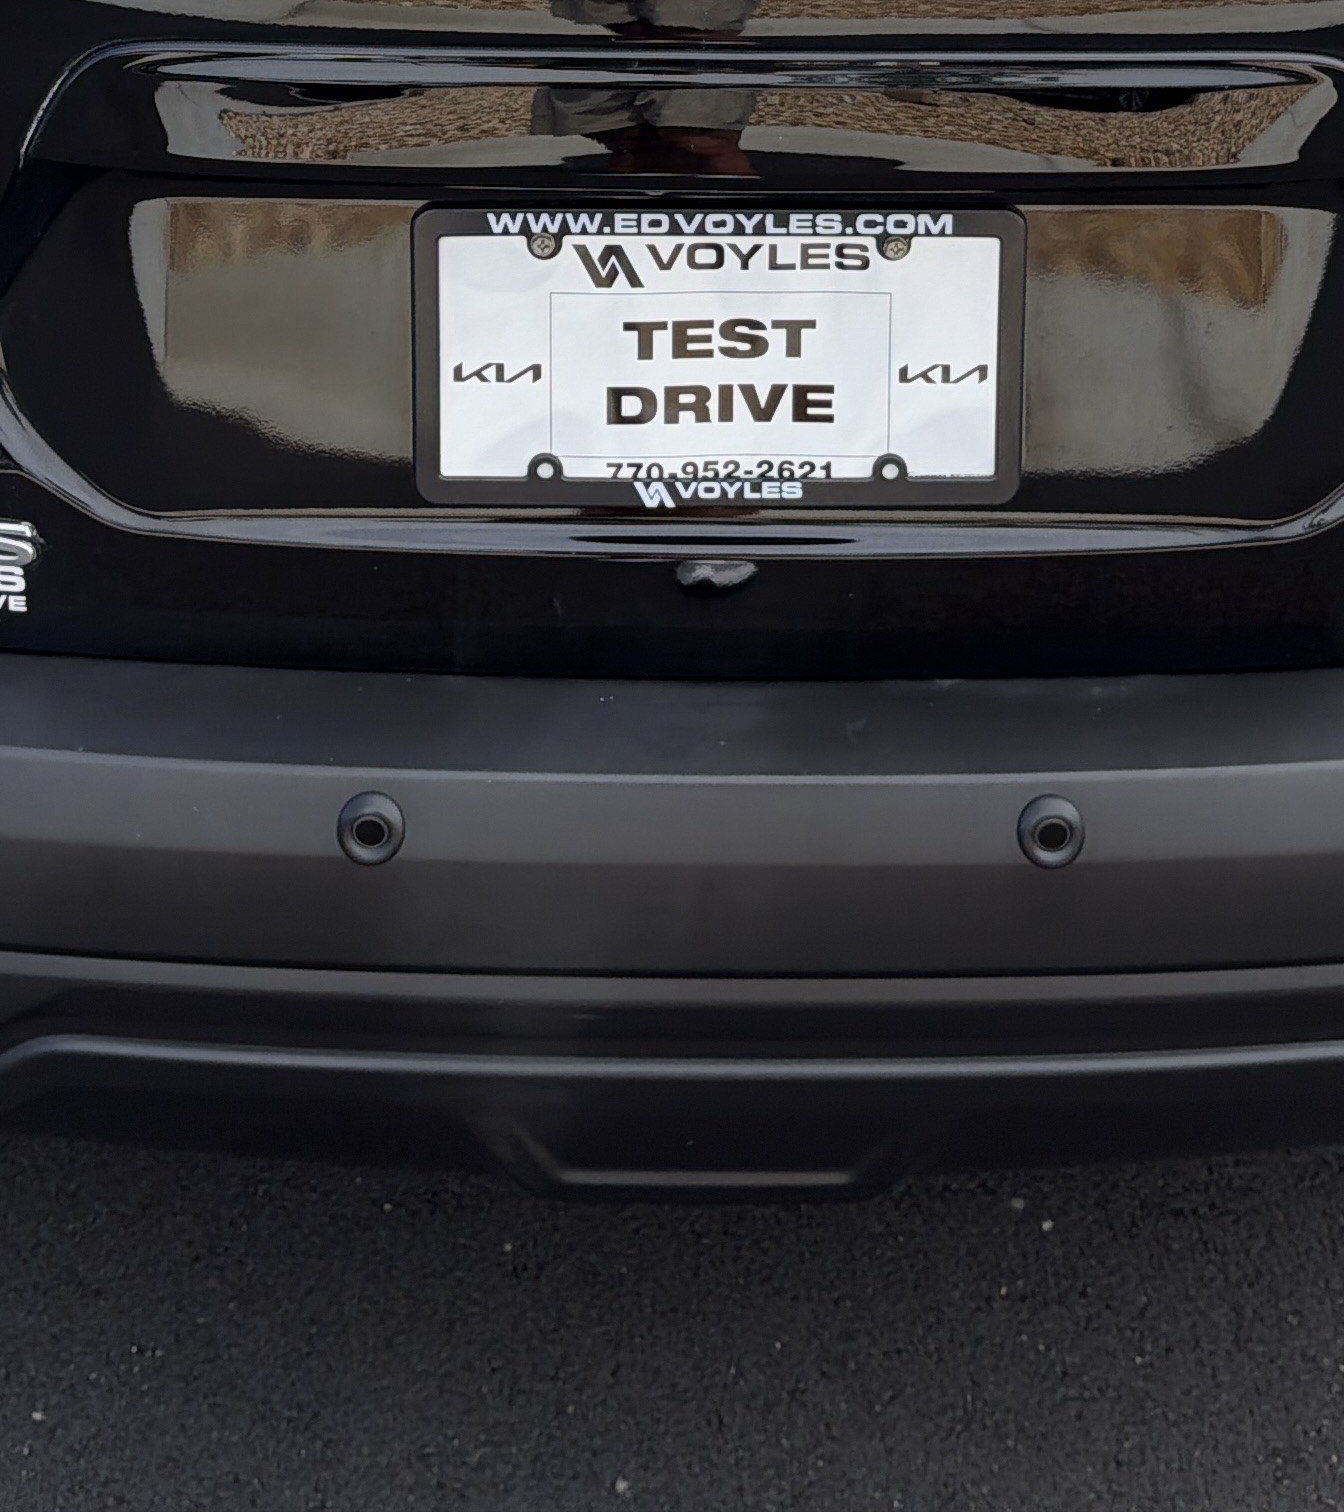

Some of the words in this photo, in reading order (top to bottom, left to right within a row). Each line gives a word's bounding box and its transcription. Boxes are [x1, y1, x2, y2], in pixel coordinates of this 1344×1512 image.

[486, 211, 954, 235] WWW.EDVOYLES.COM
[644, 242, 871, 272] VOYLES
[622, 318, 817, 361] TEST
[605, 383, 835, 426] DRIVE
[605, 459, 833, 480] 770-952-2621
[674, 481, 803, 499] VOYLES
